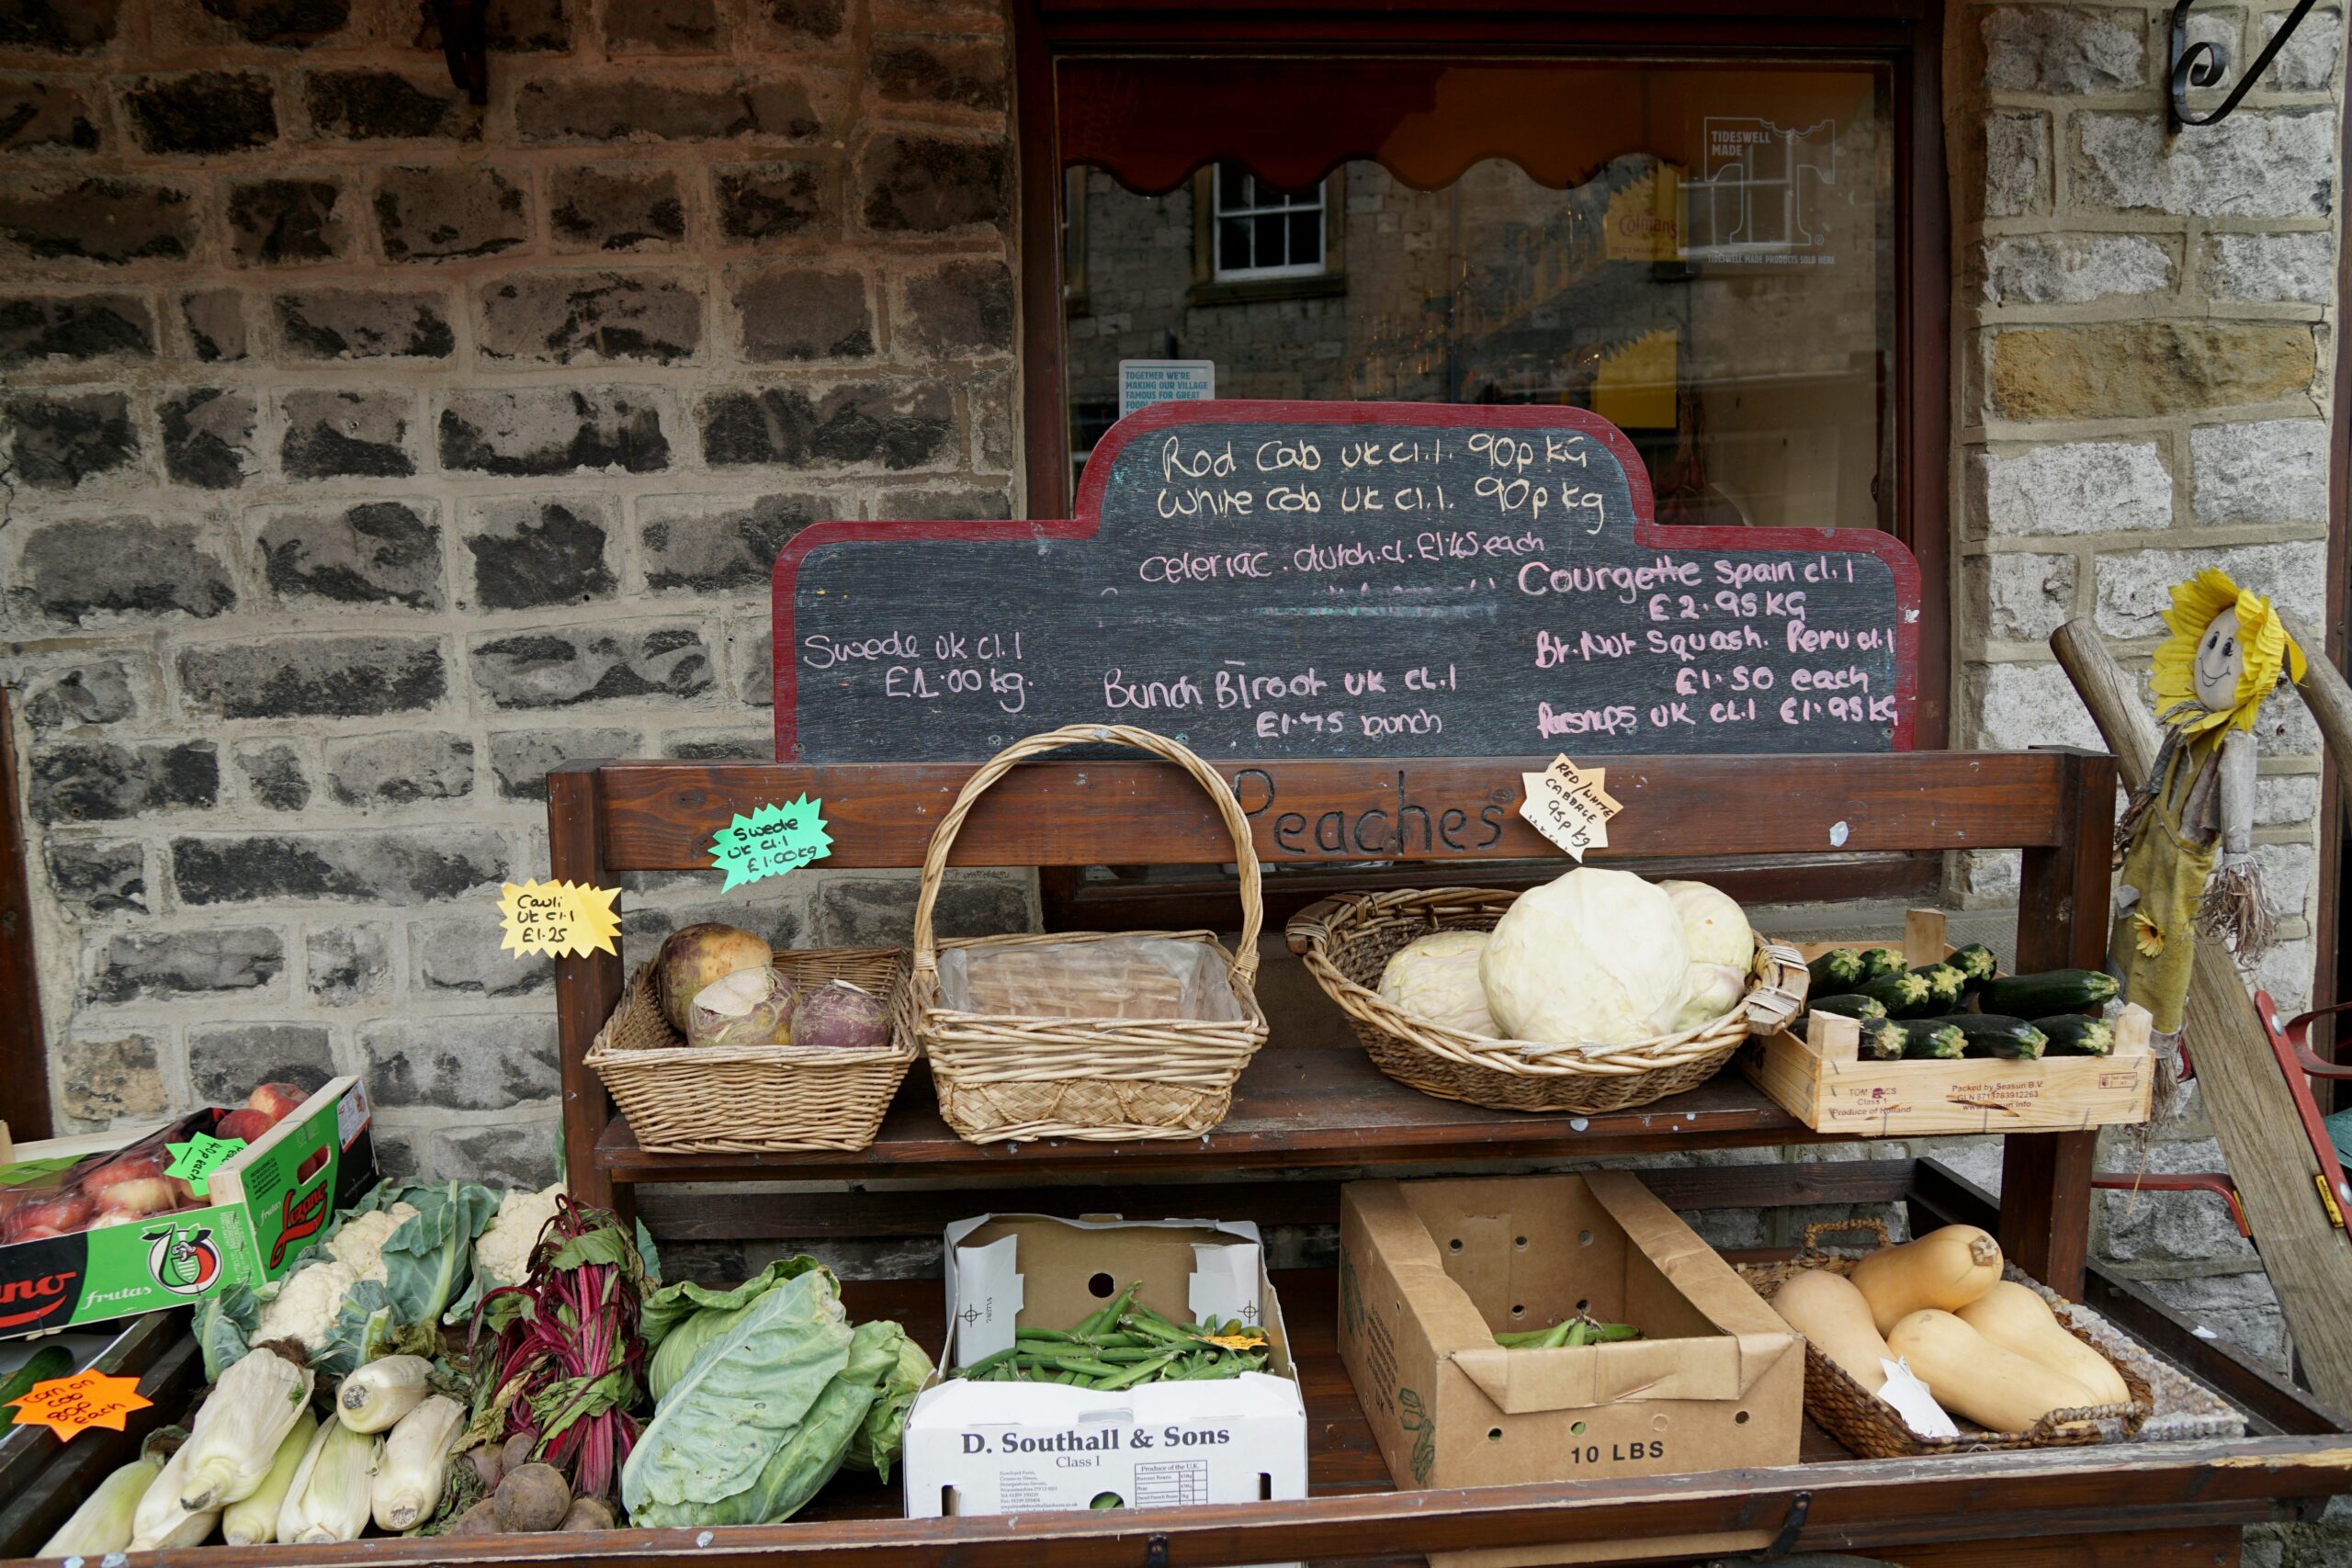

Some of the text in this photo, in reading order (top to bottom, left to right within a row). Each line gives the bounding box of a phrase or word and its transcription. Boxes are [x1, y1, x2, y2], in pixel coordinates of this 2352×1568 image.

[1712, 130, 1771, 144] TIDESWELL
[1712, 144, 1743, 157] MADE
[1745, 255, 1763, 265] MADE
[1765, 255, 1798, 265] PRODUCTS
[1800, 255, 1816, 265] SOLD
[1818, 256, 1836, 265] HERE
[1125, 371, 1191, 380] TOGETHER WE'RE
[1125, 381, 1208, 389] MAKING OUR VILLAGE
[1125, 390, 1200, 400] FAMOUS FOR GREAT
[1468, 434, 1533, 474] 90p
[1158, 487, 1253, 519] White
[1475, 477, 1548, 520] 90p
[1482, 531, 1545, 557] each
[1519, 555, 1701, 604] Courgette
[1713, 558, 1794, 589] Spain
[1787, 619, 1849, 654] Peru
[803, 630, 921, 669] Swede
[1103, 667, 1204, 709] Bunch
[1675, 665, 1869, 696] £1.50 each
[1233, 768, 1506, 856] Peaches
[1545, 778, 1597, 824] CABBAGE
[733, 818, 797, 841] Swede
[517, 895, 563, 908] Cauli
[523, 927, 568, 942] £1.25
[1952, 1084, 1982, 1092] Packed
[1984, 1083, 1994, 1093] by
[1996, 1081, 2027, 1090] Seasun
[1832, 1108, 1867, 1116] Produce
[260, 1201, 281, 1227] frutas
[82, 1286, 153, 1310] frutas
[24, 1379, 95, 1404] Corn on
[74, 1403, 126, 1424] each
[961, 1426, 1231, 1454] D. Southall & Sons
[1571, 1440, 1665, 1464] 10 LBS
[1056, 1457, 1092, 1468] Class
